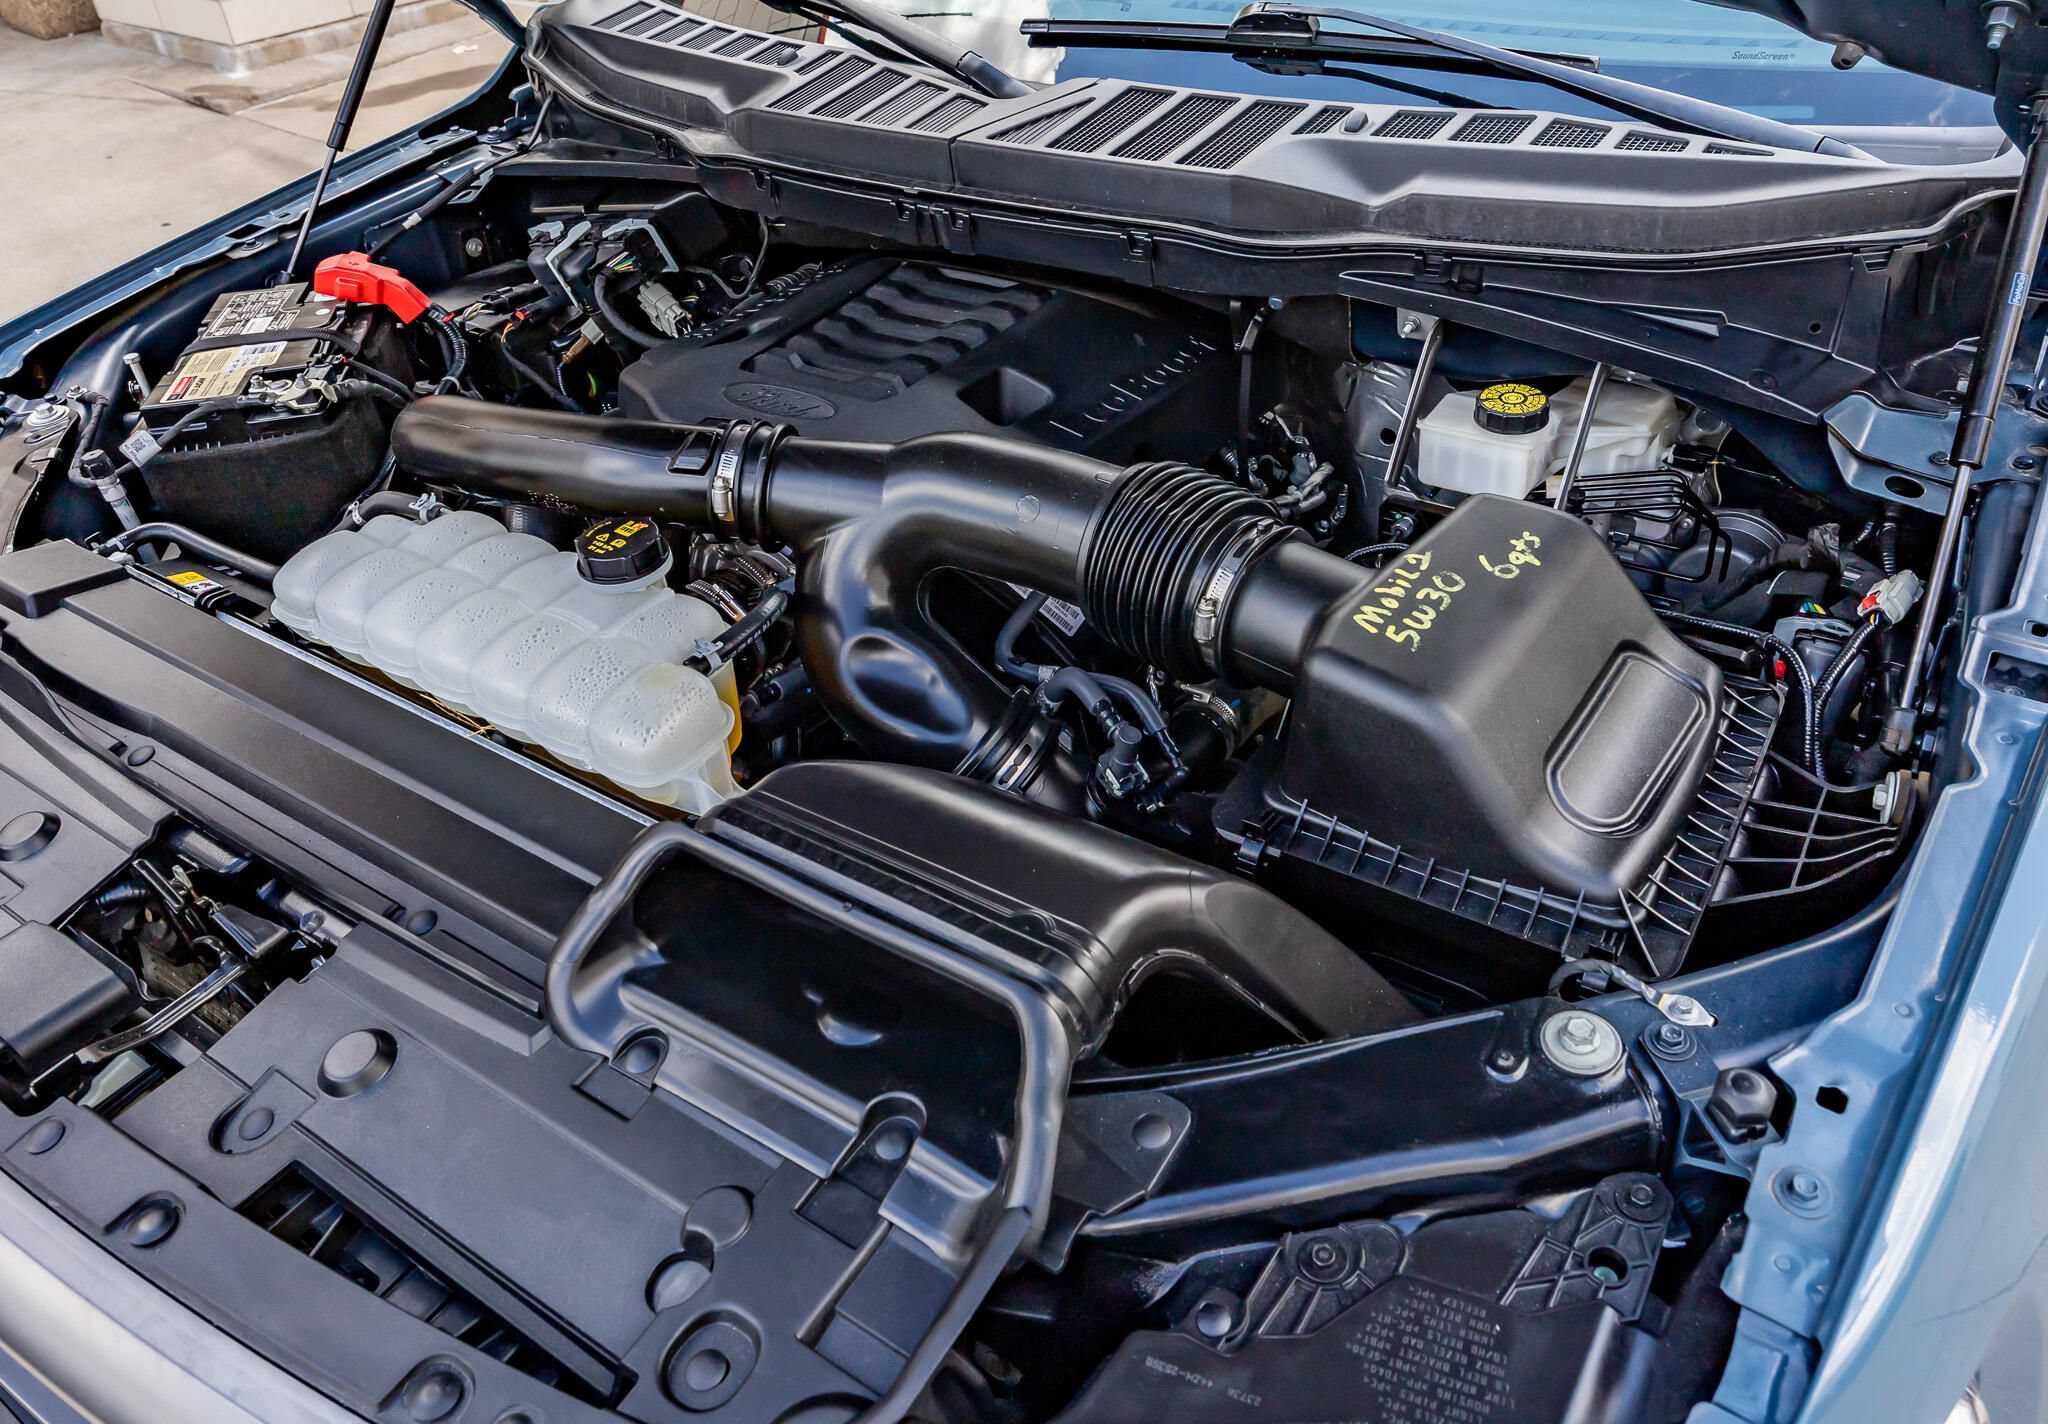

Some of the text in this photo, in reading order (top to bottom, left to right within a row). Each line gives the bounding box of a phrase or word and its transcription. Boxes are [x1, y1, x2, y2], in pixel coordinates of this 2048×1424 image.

[1732, 50, 1789, 60] SoundScreen
[1400, 1347, 1450, 1373] BRACKET
[1424, 1369, 1478, 1396] BRACKET
[1398, 1388, 1438, 1411] PIPES
[1436, 1387, 1491, 1416] HOUSING
